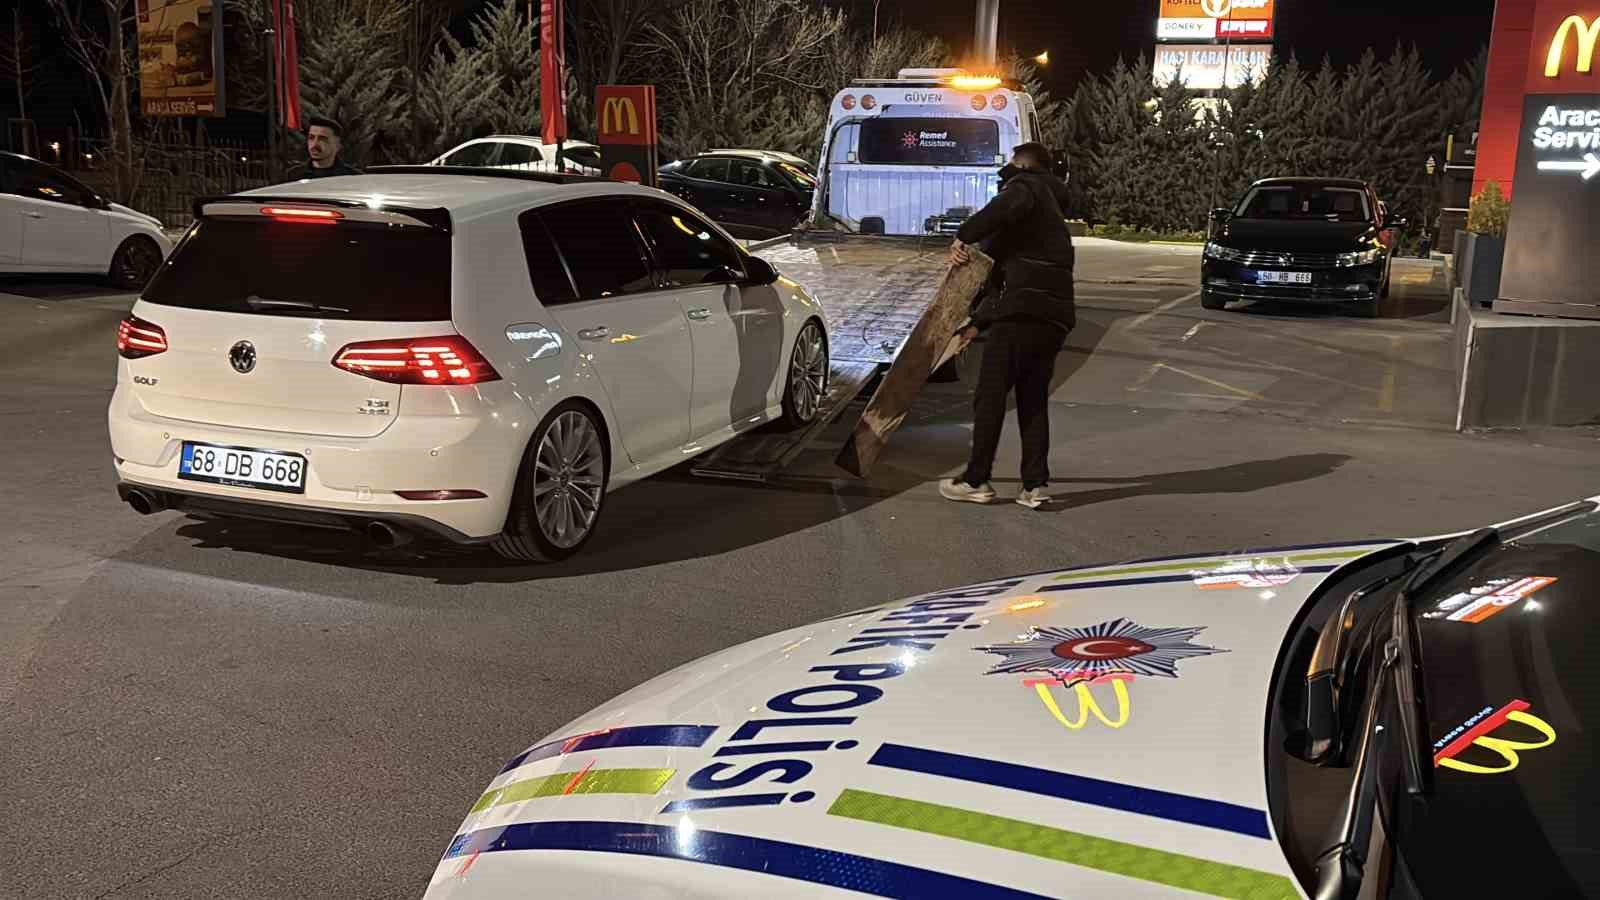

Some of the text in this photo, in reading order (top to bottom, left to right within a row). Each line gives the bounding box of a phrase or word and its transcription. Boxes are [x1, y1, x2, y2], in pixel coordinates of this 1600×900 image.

[904, 90, 943, 103] GÜVEN
[919, 131, 948, 140] Remed
[133, 376, 159, 386] GOLF
[192, 448, 216, 472] 68
[225, 452, 254, 477] DB
[262, 457, 301, 483] 668
[658, 662, 905, 814] POLİSİ
